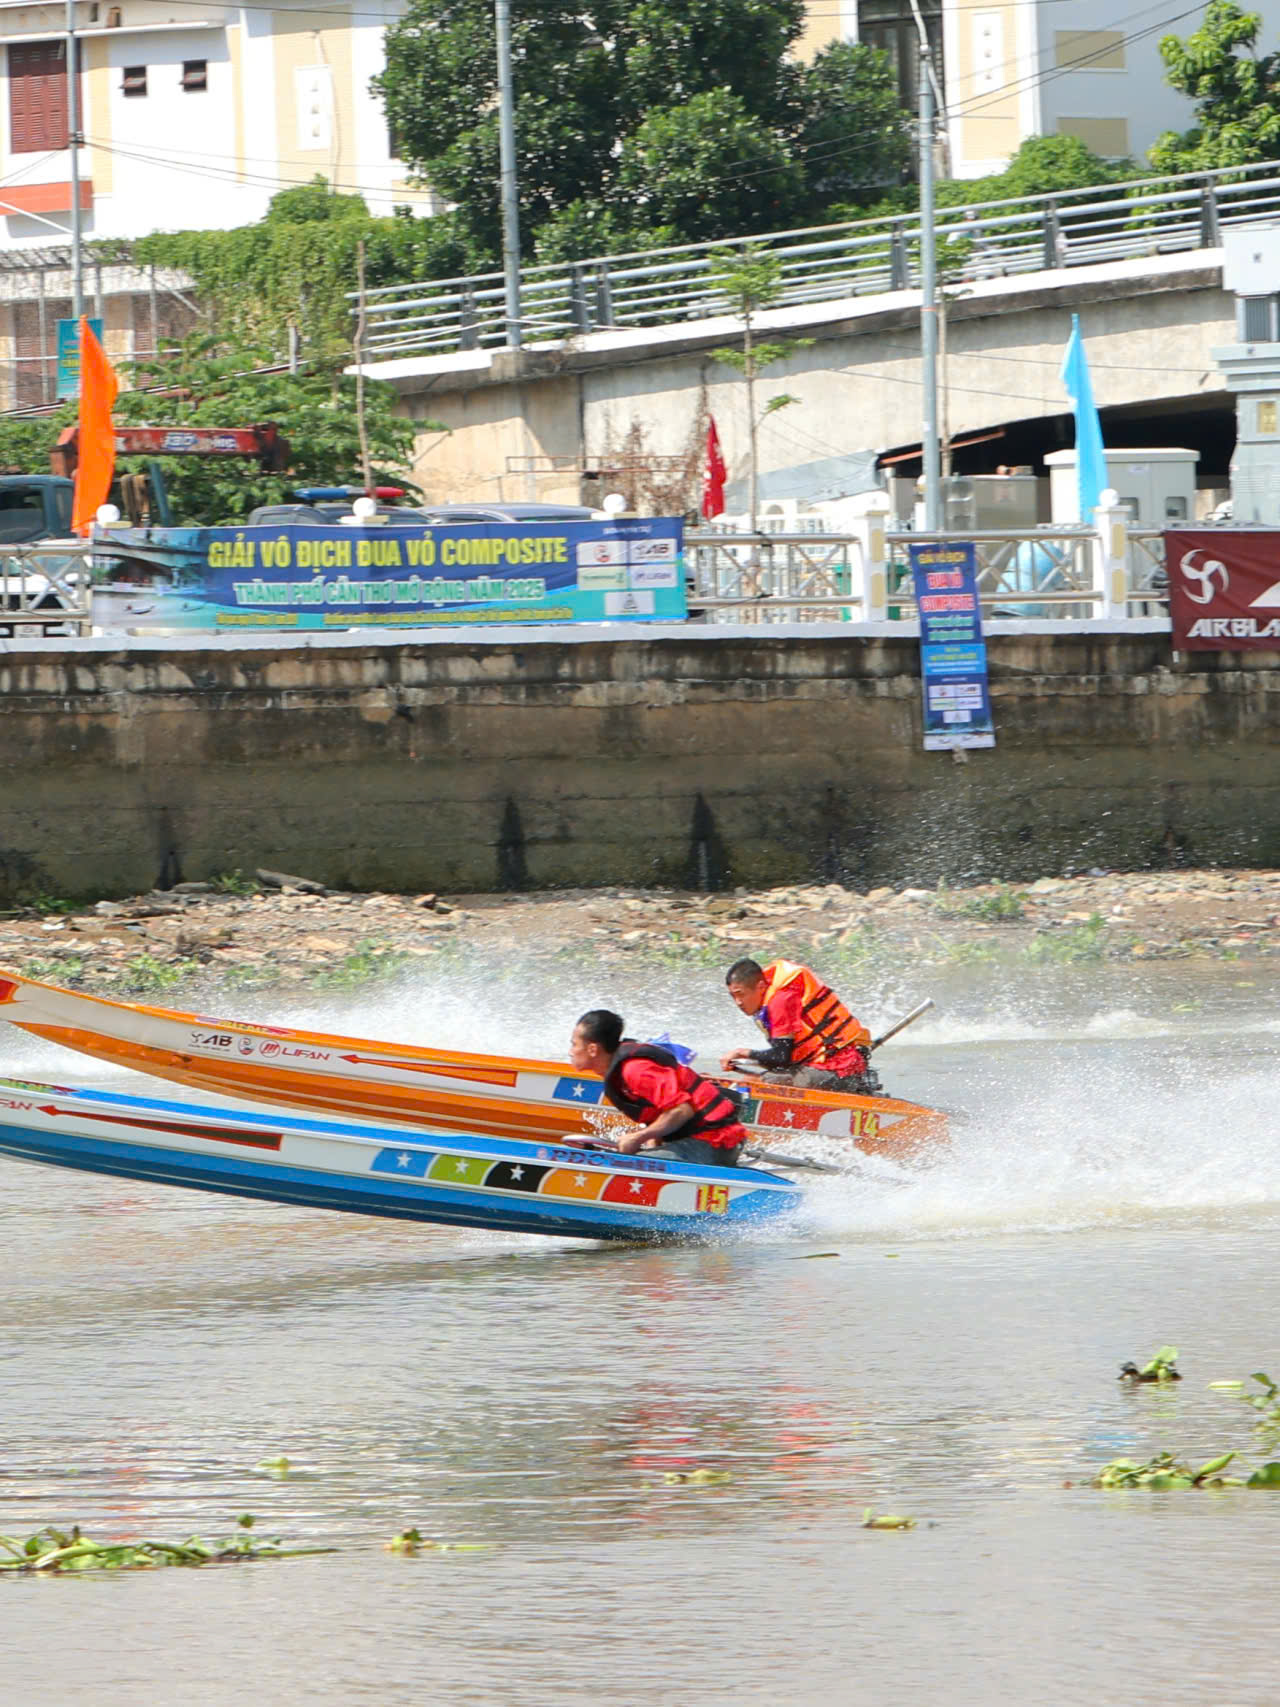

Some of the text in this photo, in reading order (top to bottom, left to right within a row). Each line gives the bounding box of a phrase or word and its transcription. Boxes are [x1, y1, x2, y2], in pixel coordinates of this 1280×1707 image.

[208, 531, 568, 573] GIẢI VÔ ĐỊCH ĐUA VỎ COMPOSITE
[233, 575, 545, 607] THÀNH PHỐ CẦN THƠ MỞ RỘNG NĂM 2025
[281, 1046, 333, 1061] LIFAN
[852, 1111, 878, 1137] 14
[697, 1184, 728, 1215] 15
